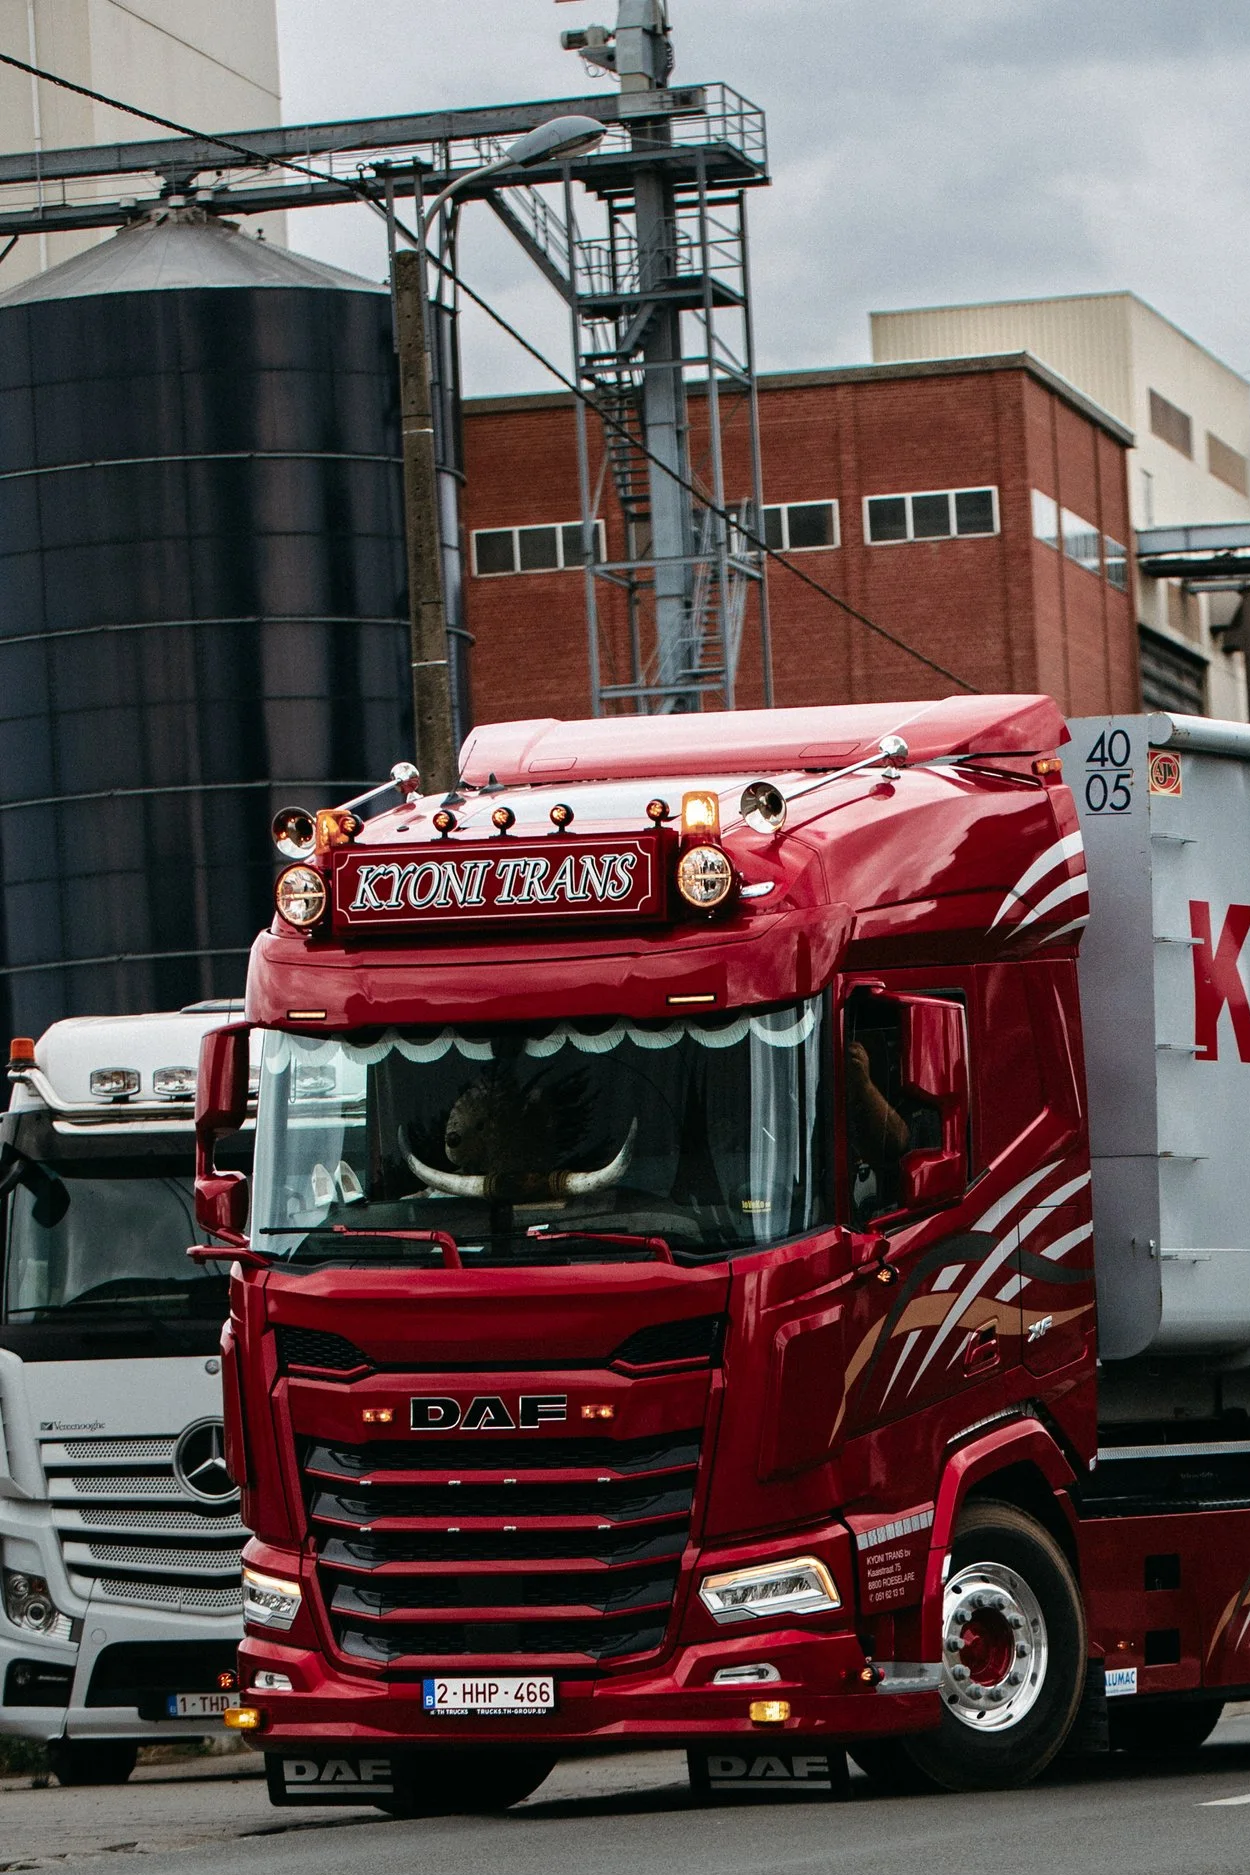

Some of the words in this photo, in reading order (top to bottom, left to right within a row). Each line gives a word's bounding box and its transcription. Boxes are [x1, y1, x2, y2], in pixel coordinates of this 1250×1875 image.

[1086, 729, 1131, 767] 40
[1085, 773, 1131, 812] 05
[350, 859, 492, 910] KYONI
[493, 852, 637, 904] TRANS
[410, 1394, 567, 1431] DAF
[866, 1554, 885, 1565] KYONI
[885, 1549, 904, 1560] TRANS
[282, 1760, 392, 1781] DAF
[706, 1756, 829, 1777] DAF
